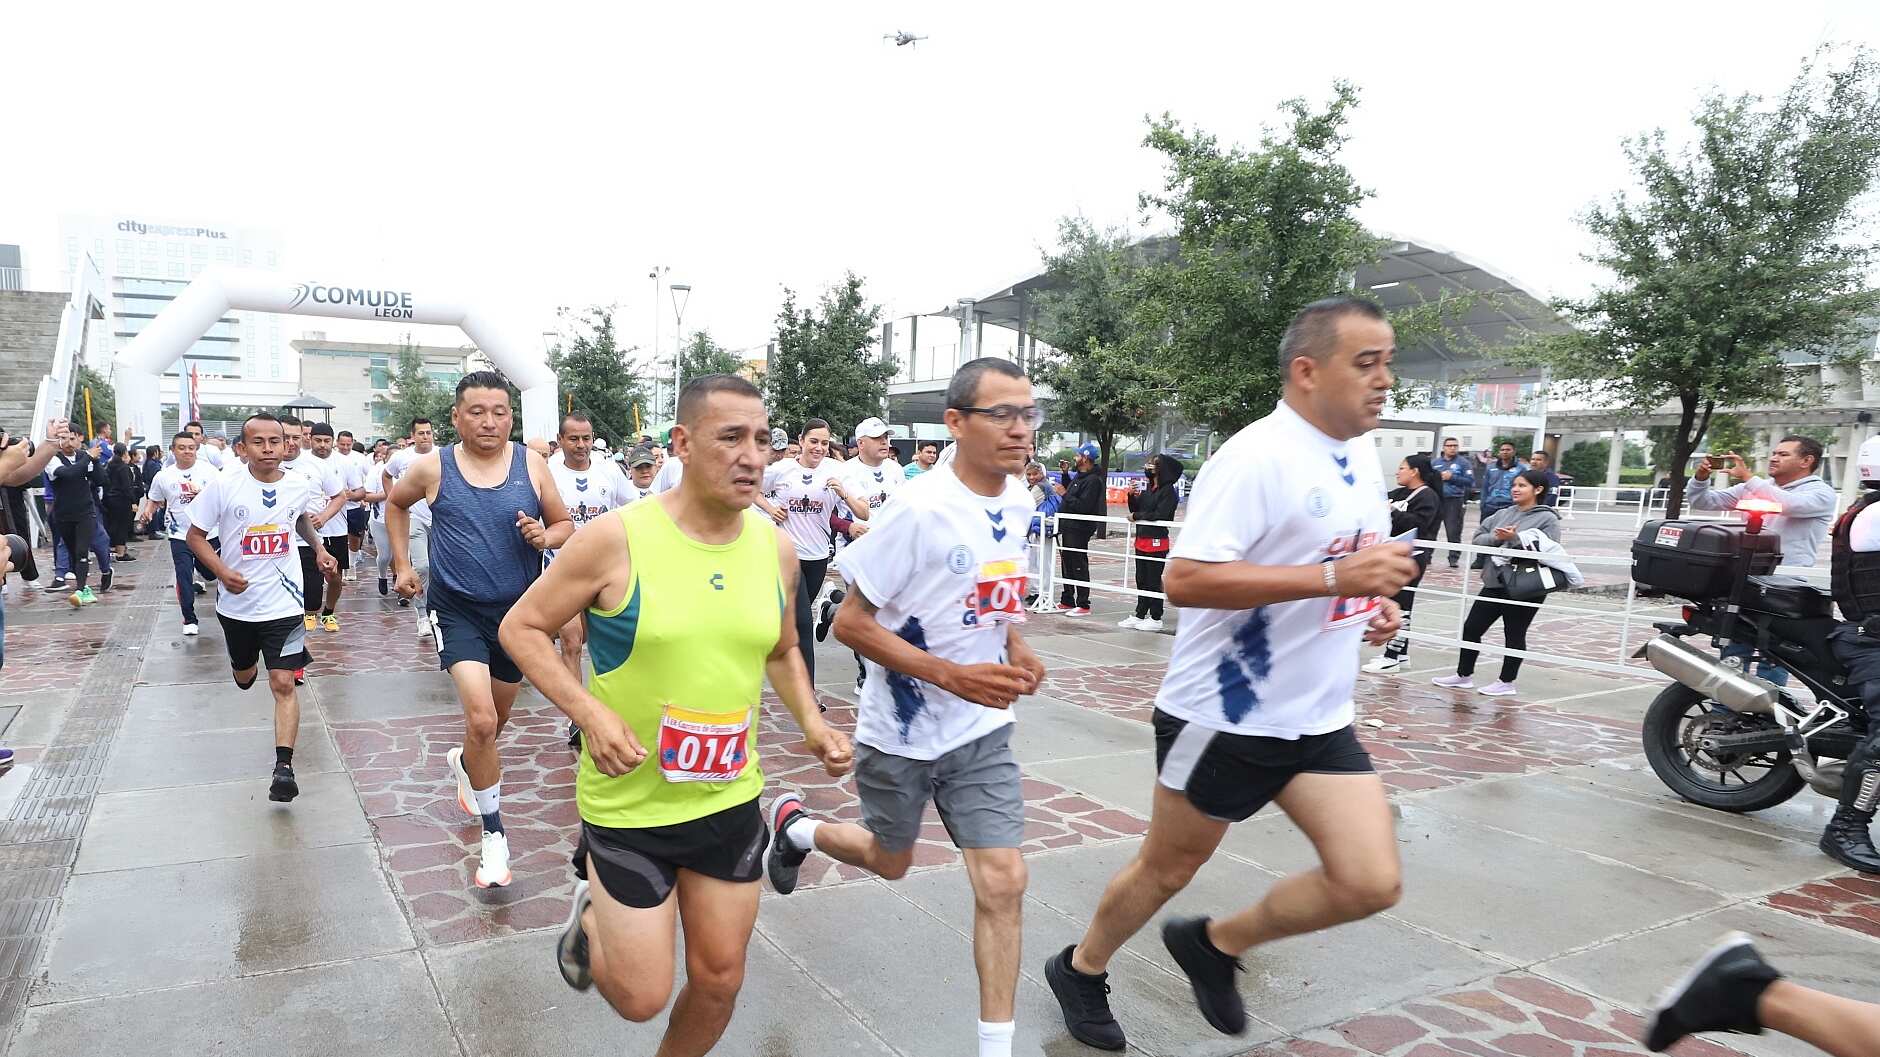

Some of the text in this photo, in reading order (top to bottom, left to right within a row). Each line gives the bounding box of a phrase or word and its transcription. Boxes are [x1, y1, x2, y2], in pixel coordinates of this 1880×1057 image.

[311, 285, 413, 308] COMUDE
[374, 305, 413, 318] LEÓN
[250, 535, 282, 553] 012
[677, 735, 740, 771] 014
